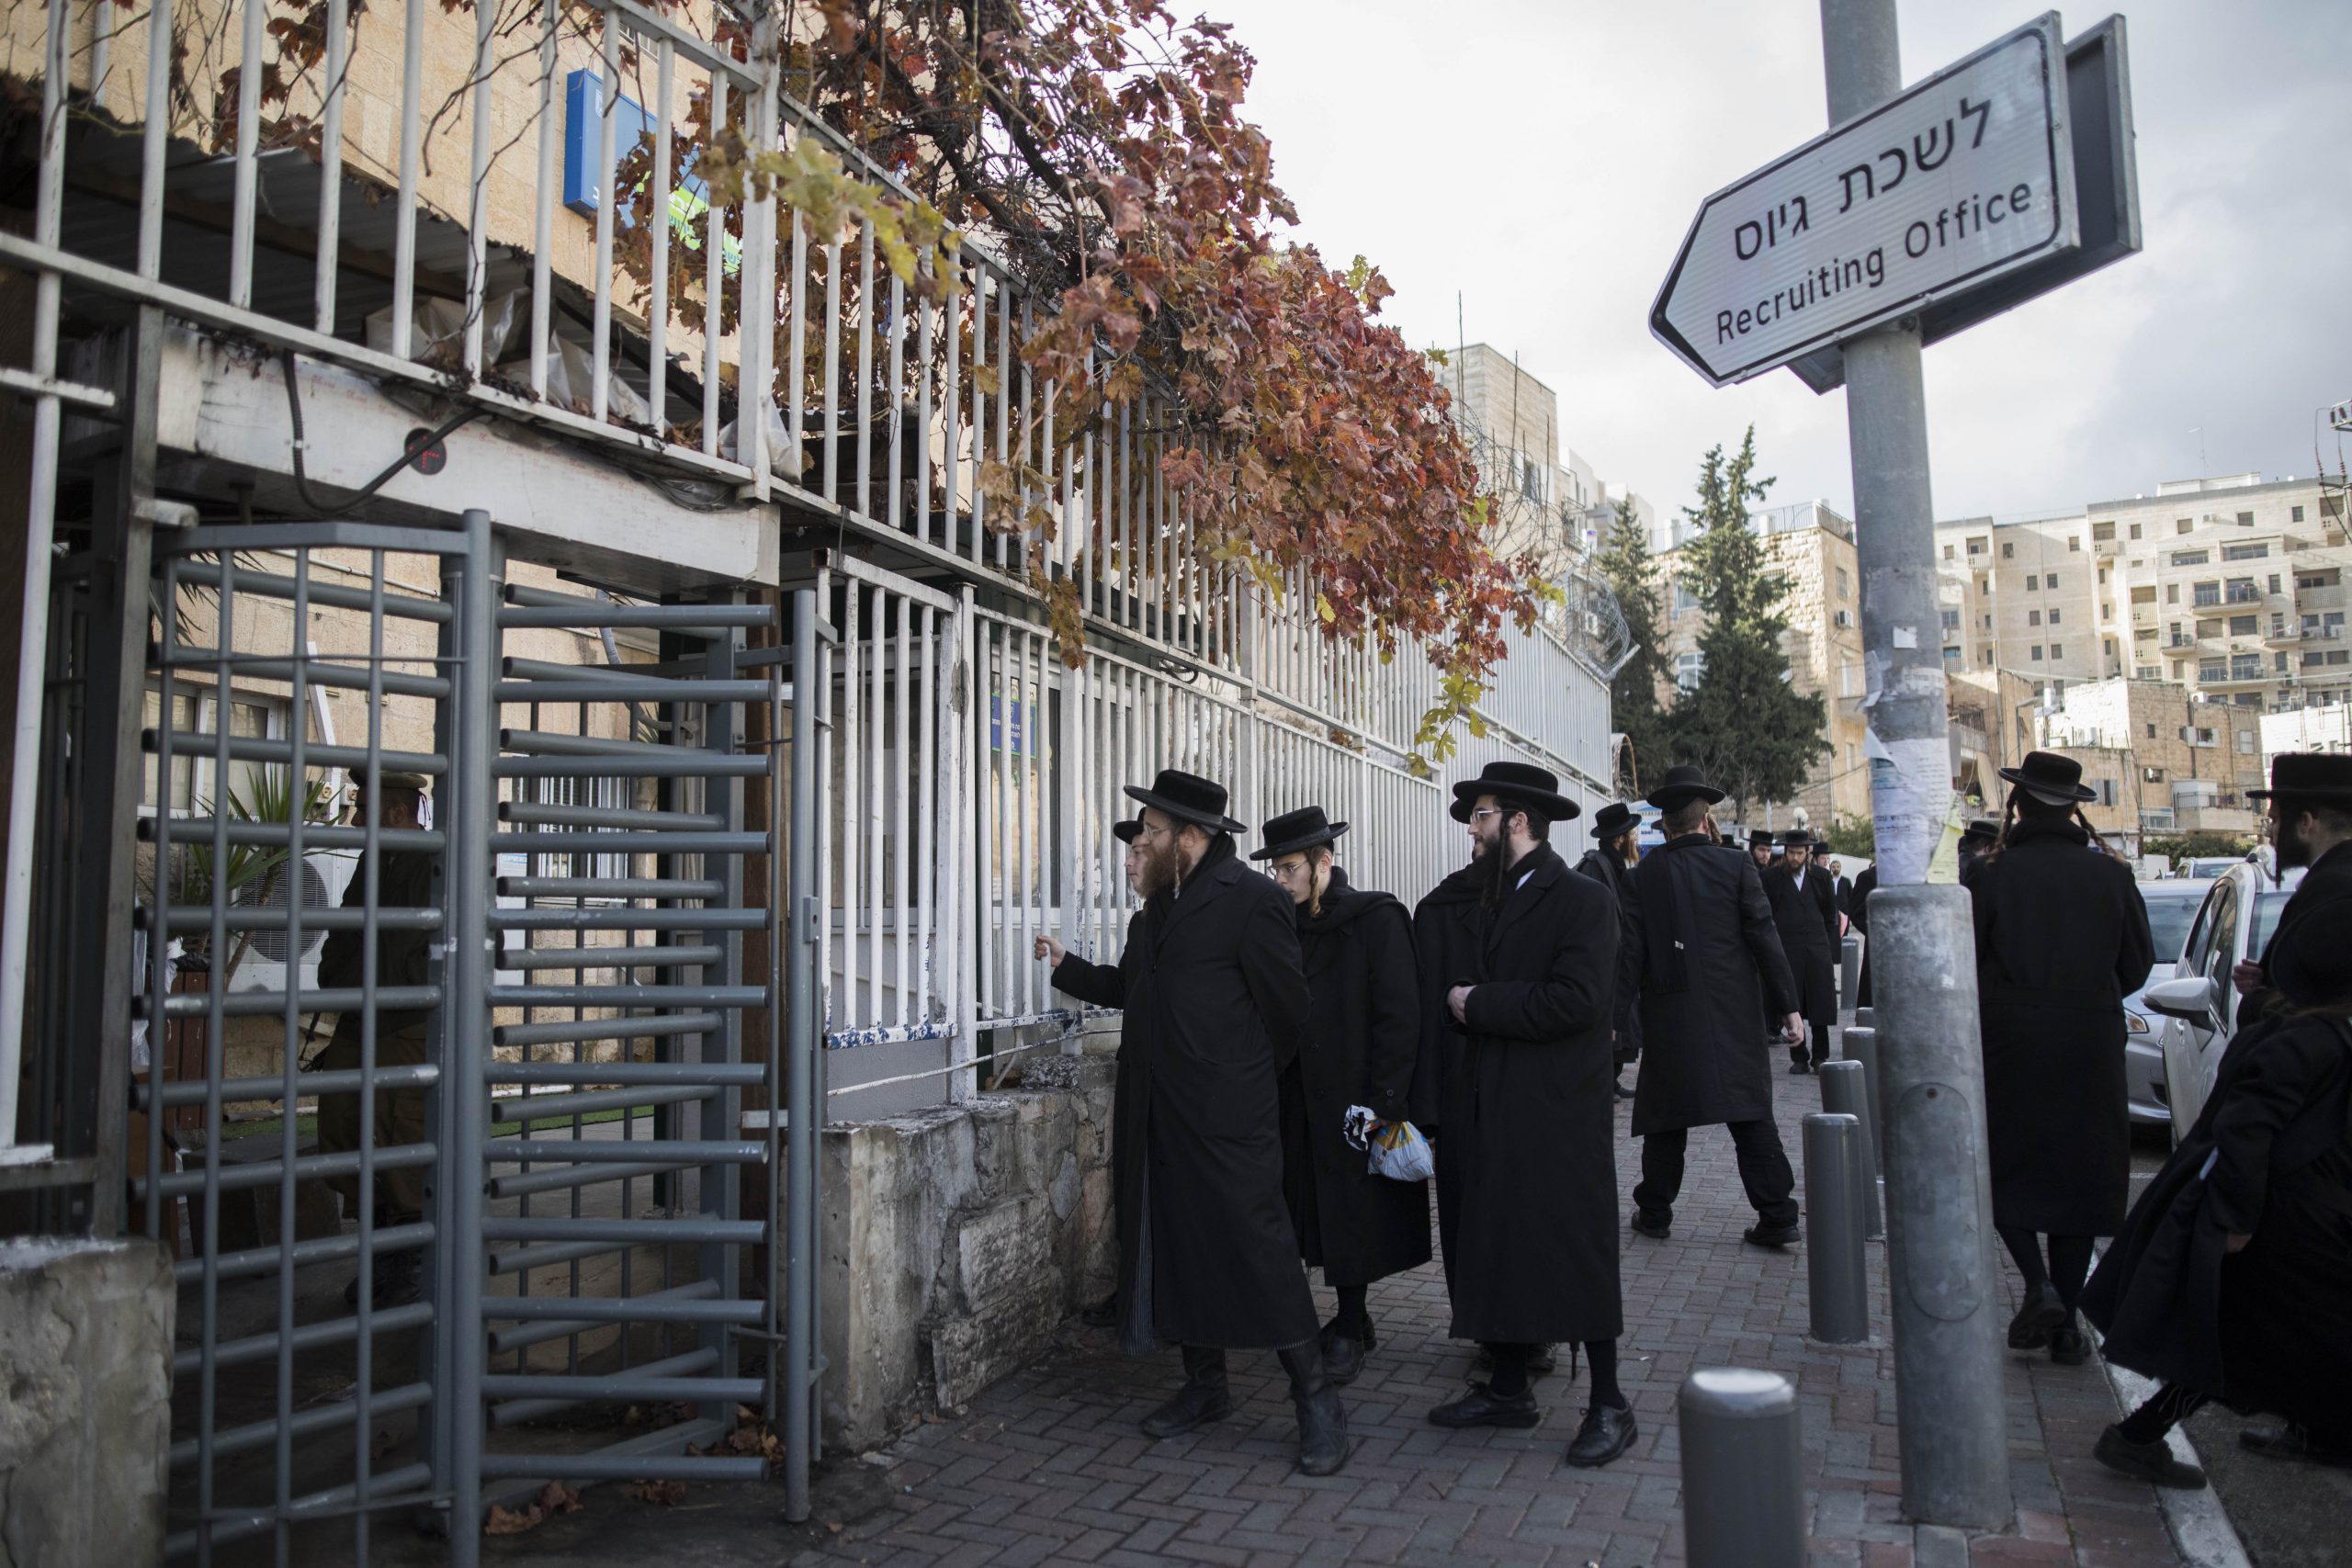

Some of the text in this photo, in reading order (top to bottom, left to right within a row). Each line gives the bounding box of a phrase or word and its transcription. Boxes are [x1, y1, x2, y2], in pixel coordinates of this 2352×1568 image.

[1734, 97, 1992, 261] לשכת גיוס
[1716, 183, 2032, 345] Recruiting Office
